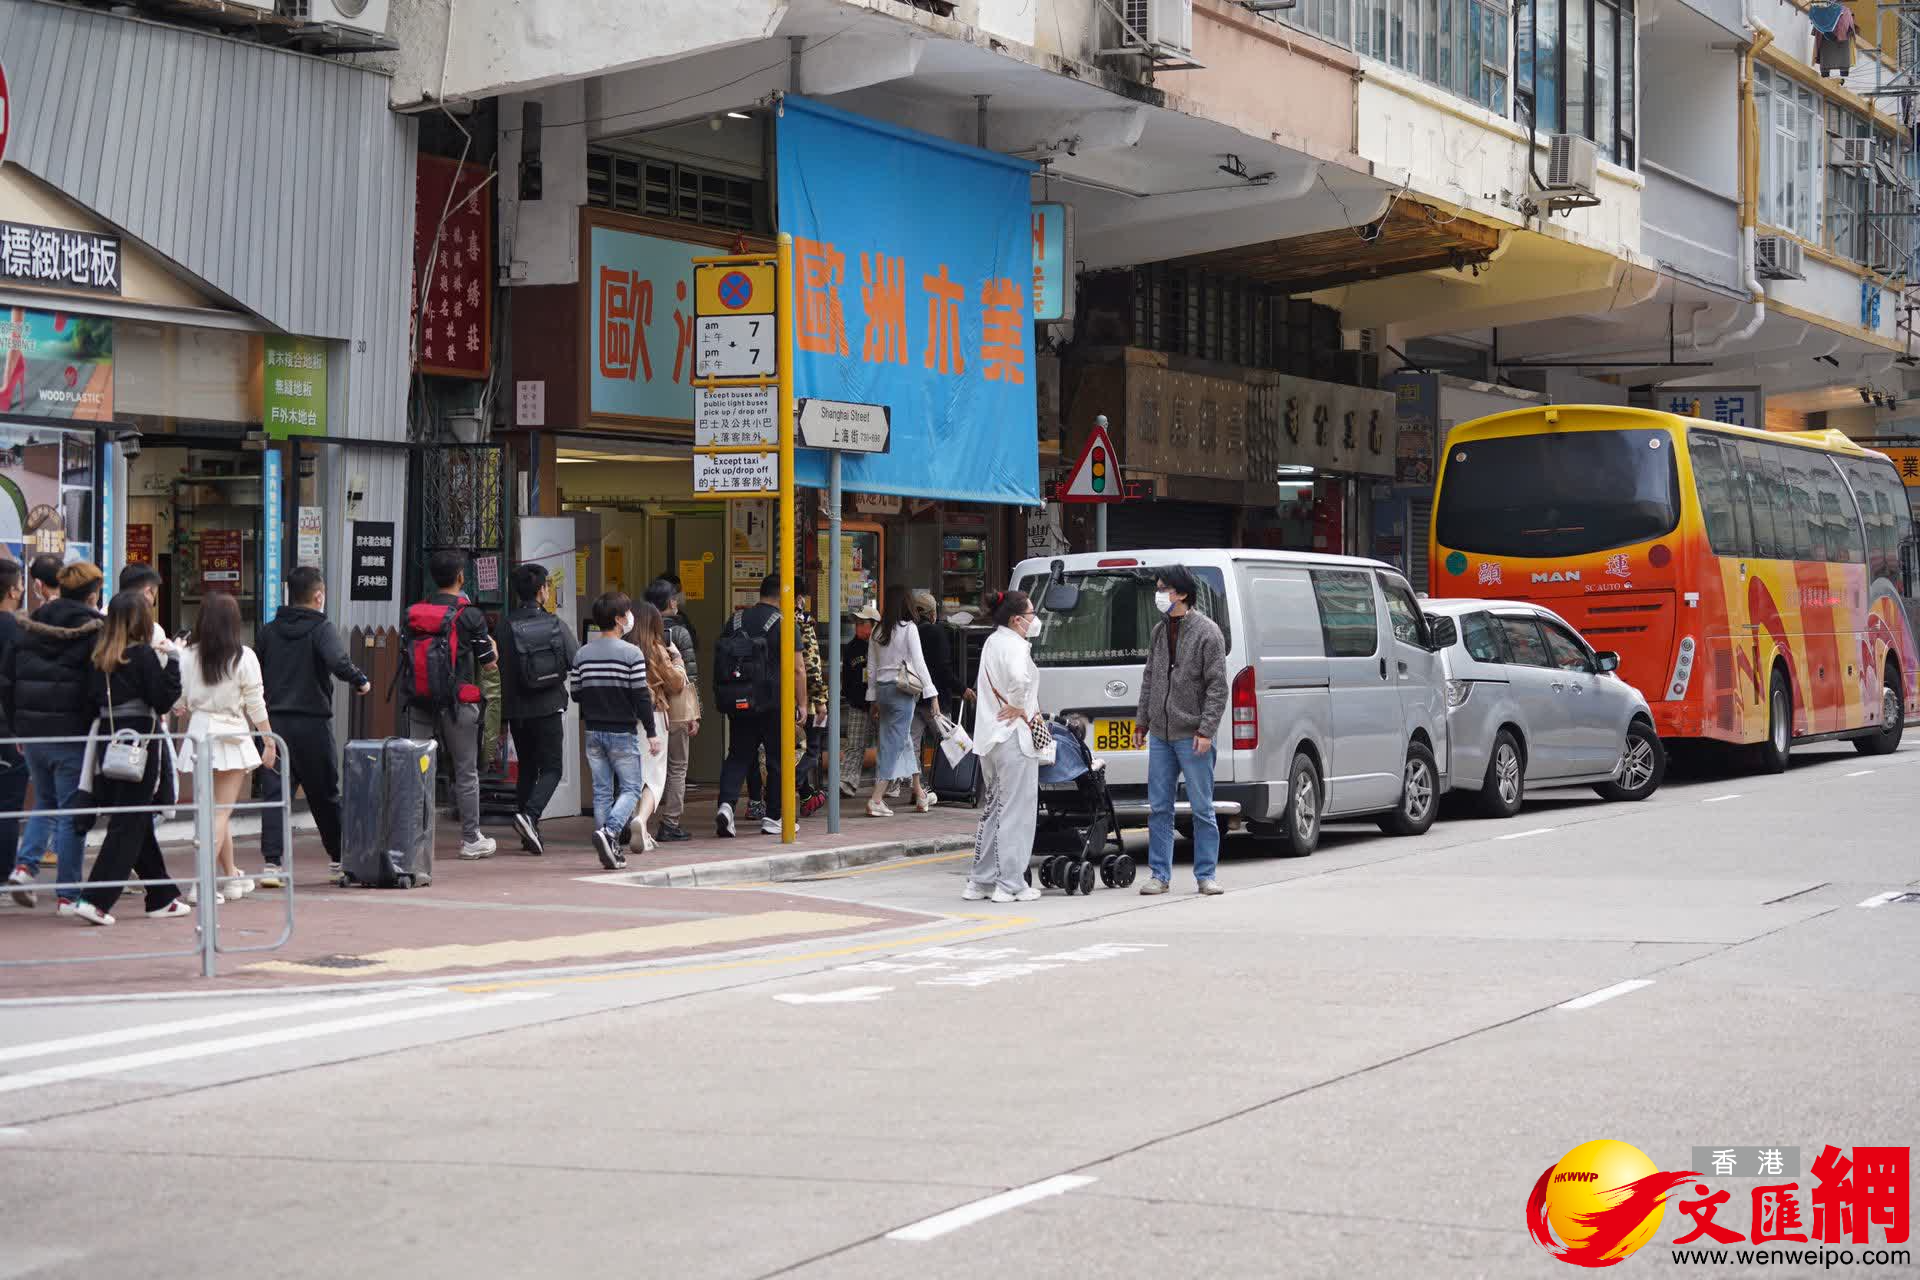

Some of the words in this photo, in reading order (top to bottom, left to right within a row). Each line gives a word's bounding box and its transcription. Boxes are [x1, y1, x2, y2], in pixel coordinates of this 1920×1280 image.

[1, 225, 117, 287] 標緻地板
[794, 236, 1025, 385] 歐洲木業
[705, 322, 719, 330] am
[749, 321, 760, 337] 7
[702, 333, 722, 343] 上午
[705, 350, 719, 358] pm
[749, 349, 760, 365] 7
[702, 360, 722, 369] 下午
[703, 391, 730, 399] Except
[731, 391, 752, 399] buses
[703, 400, 726, 408] public
[727, 400, 745, 408] light
[271, 406, 317, 426] 戶外木地台
[704, 408, 719, 416] pick
[738, 408, 755, 416] drop
[821, 406, 850, 422] Shanghai
[850, 409, 870, 422] Street
[699, 417, 773, 430] 巴士及公共小巴
[712, 431, 762, 443] 上落客除外
[832, 427, 859, 444] 上海街
[713, 457, 742, 466] Except
[743, 457, 759, 465] taxi
[703, 466, 720, 476] pick
[722, 466, 755, 476] up/drop
[757, 465, 769, 473] off
[698, 477, 773, 488] 的士上落客除外
[1605, 553, 1632, 578] 運
[1478, 562, 1502, 586] 顯
[1531, 570, 1581, 584] MAN
[1599, 583, 1621, 591] AUTO
[1108, 721, 1131, 735] RN
